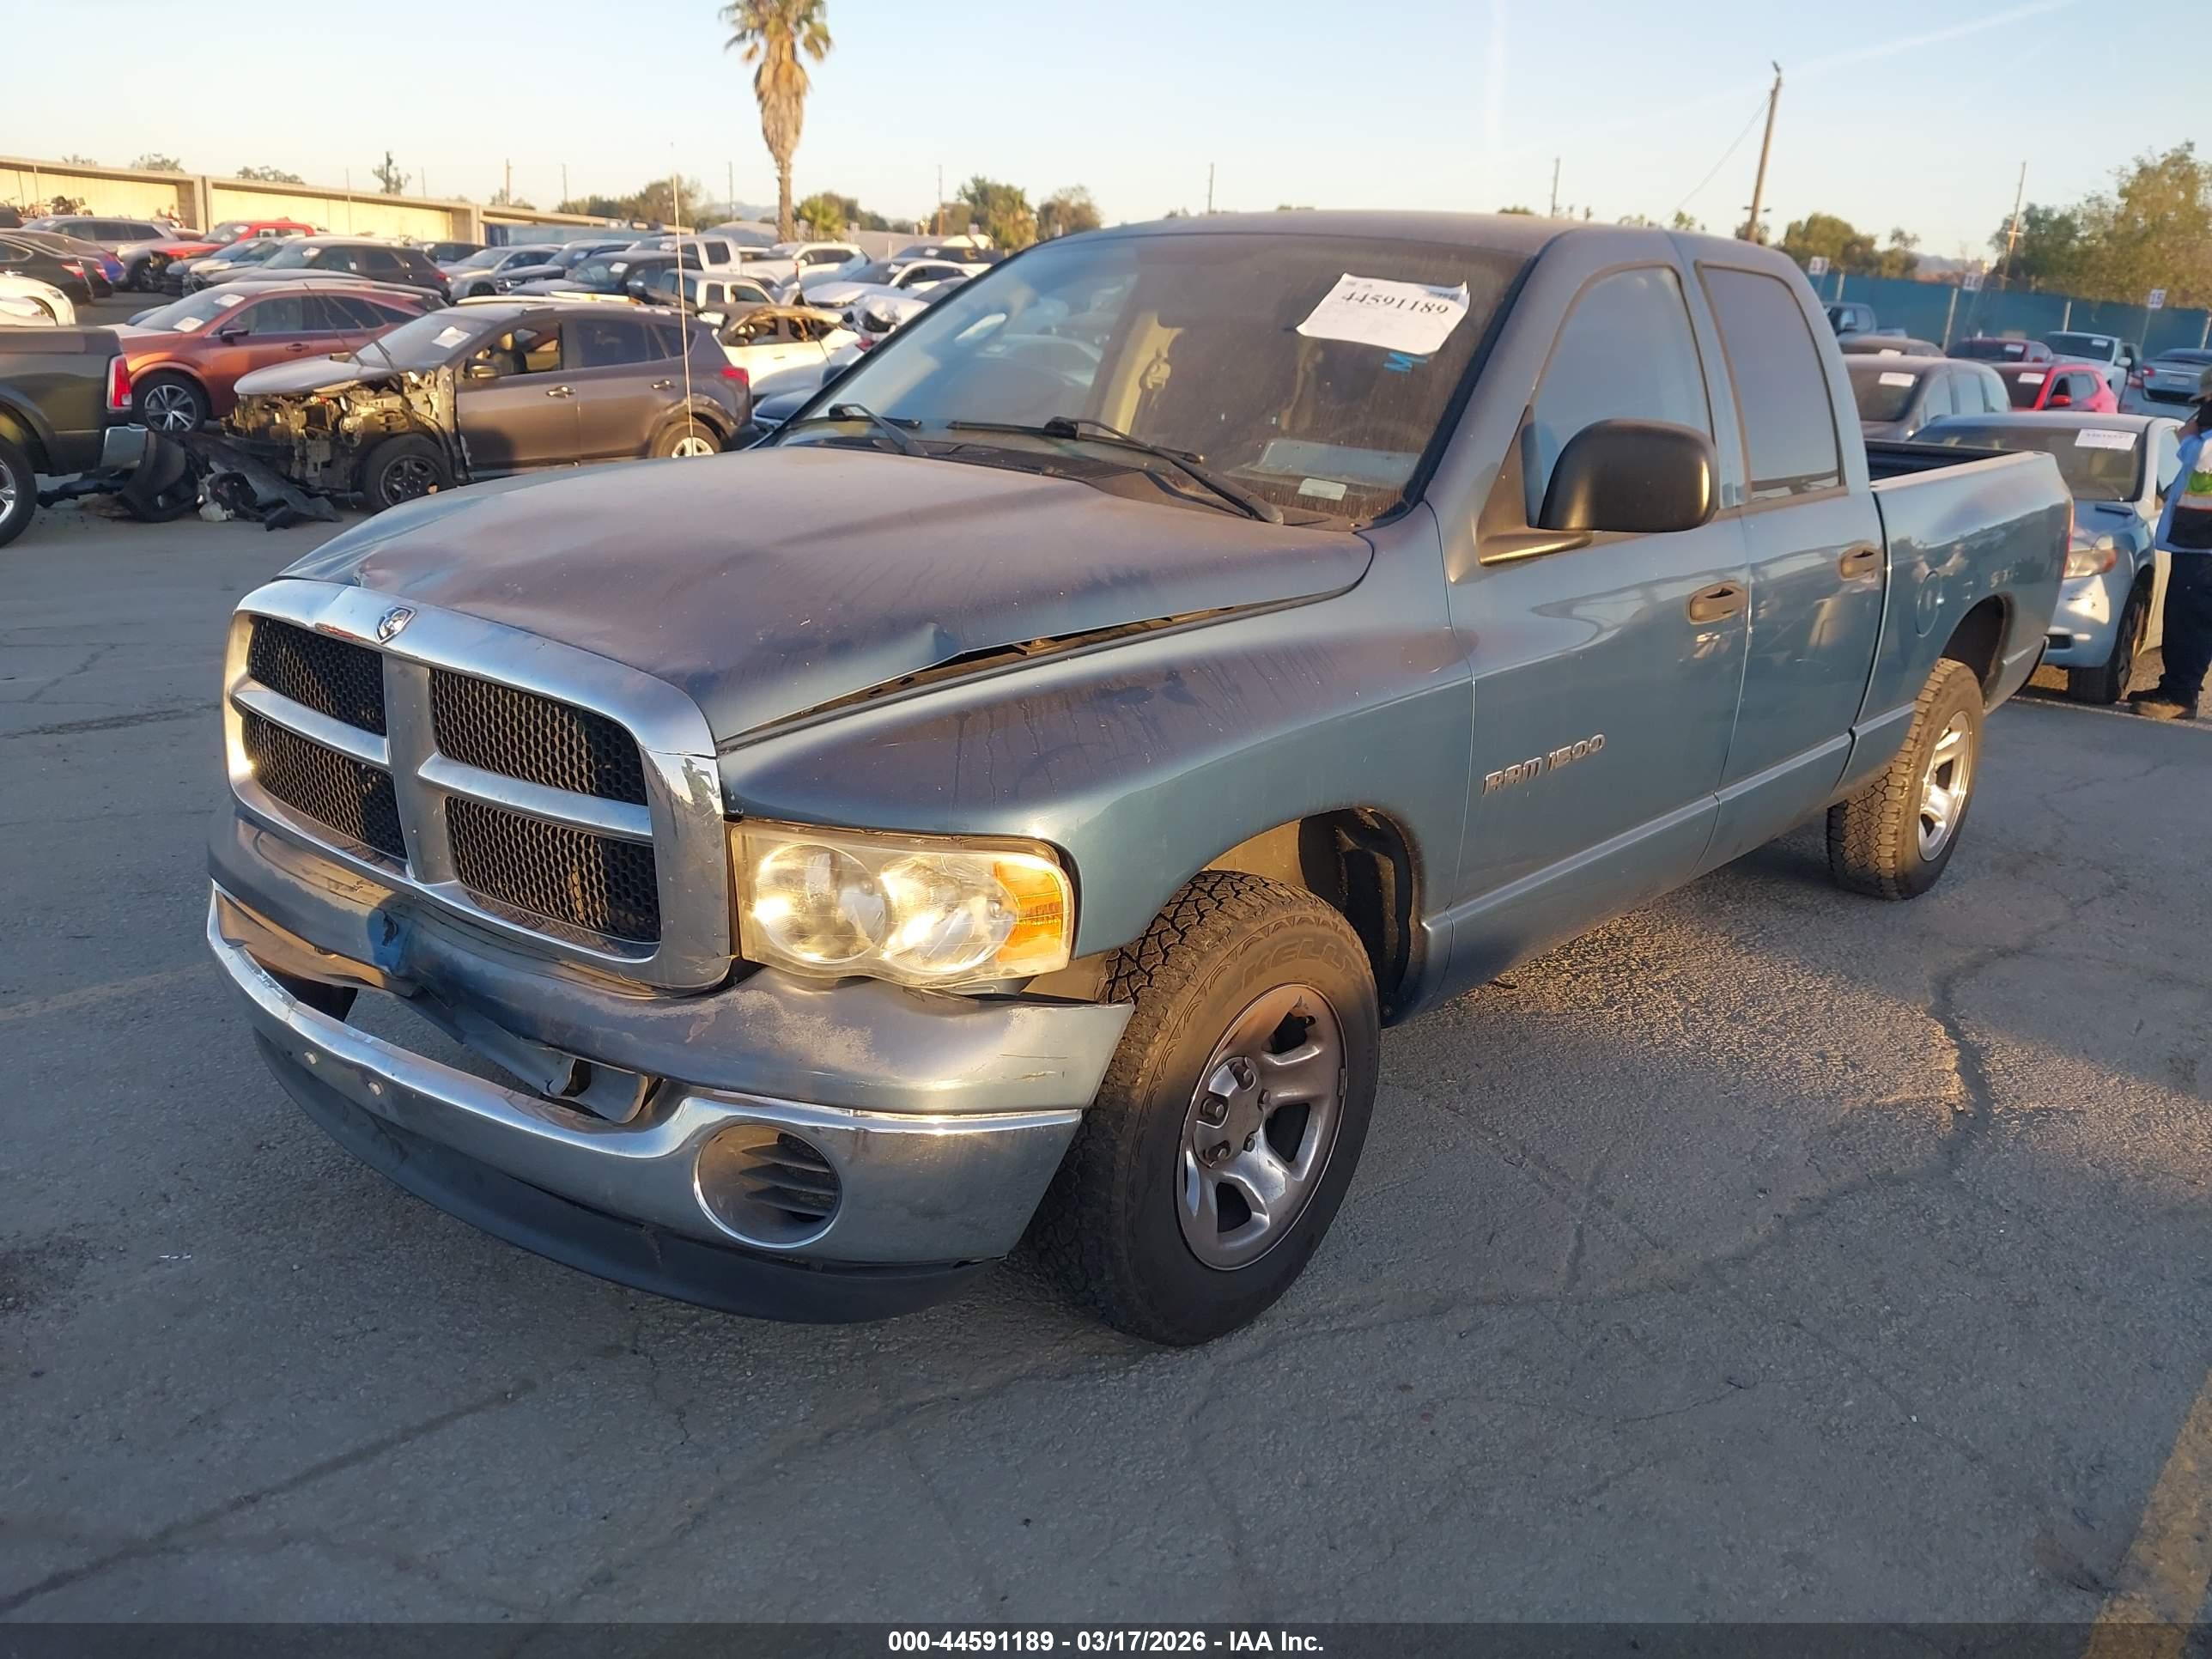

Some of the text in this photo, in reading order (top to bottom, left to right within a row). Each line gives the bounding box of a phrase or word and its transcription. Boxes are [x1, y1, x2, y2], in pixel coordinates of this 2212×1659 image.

[1342, 292, 1449, 314] 44591189
[1483, 733, 1605, 795] RAM 1500
